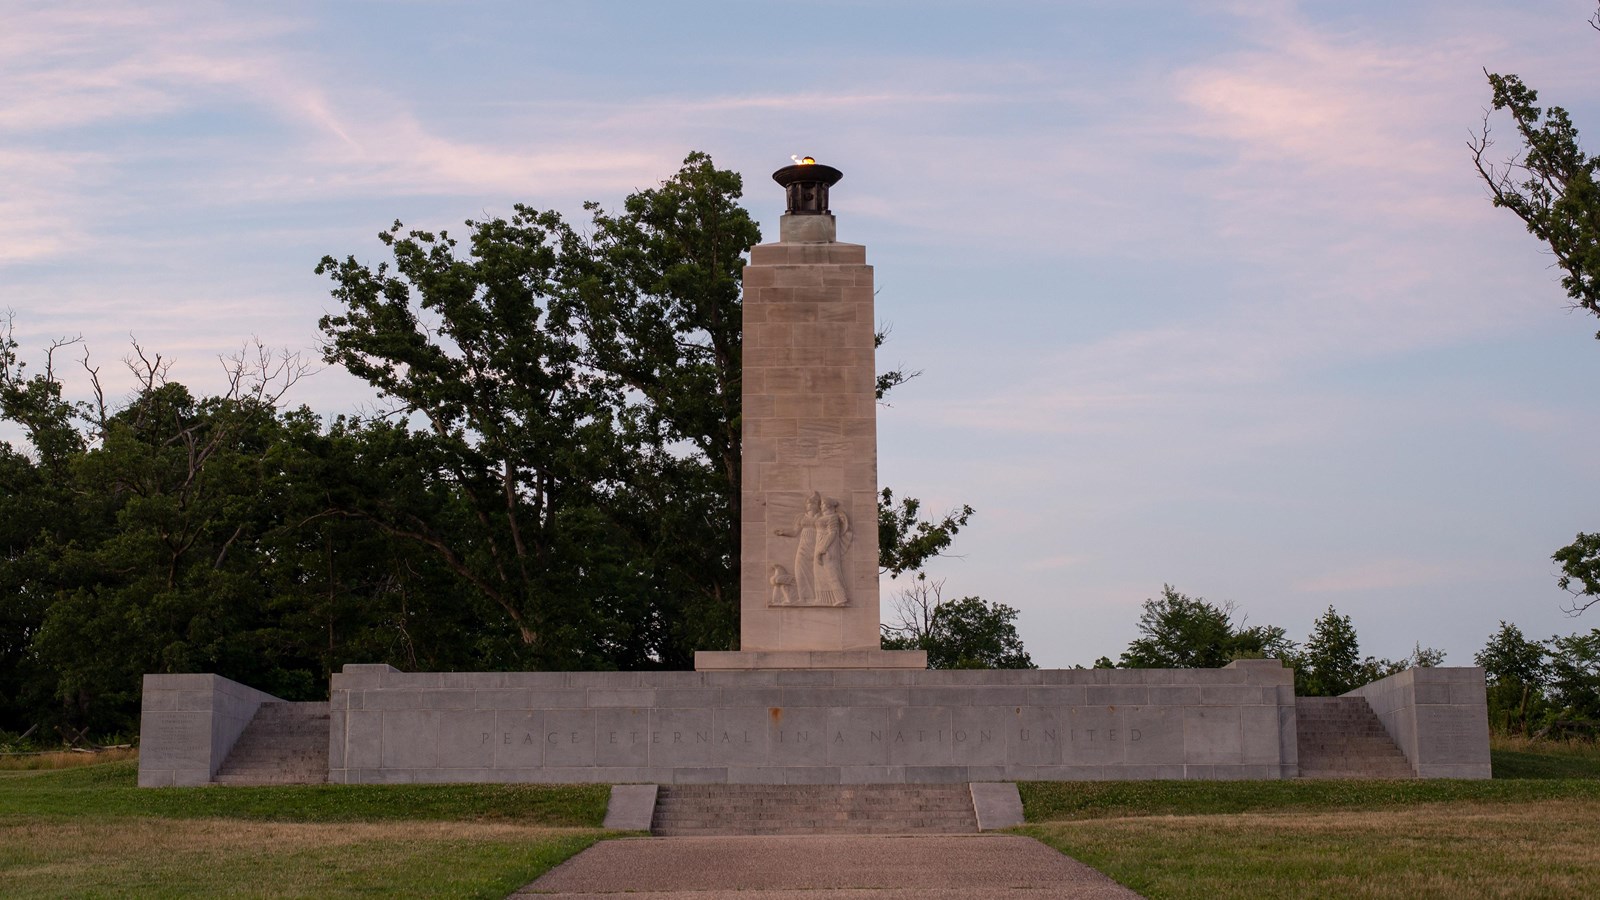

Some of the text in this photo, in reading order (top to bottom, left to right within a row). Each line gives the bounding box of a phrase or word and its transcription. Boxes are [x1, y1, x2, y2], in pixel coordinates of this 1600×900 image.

[482, 728, 1143, 744] PEACE ETERNAL IN A NATION UNITED
